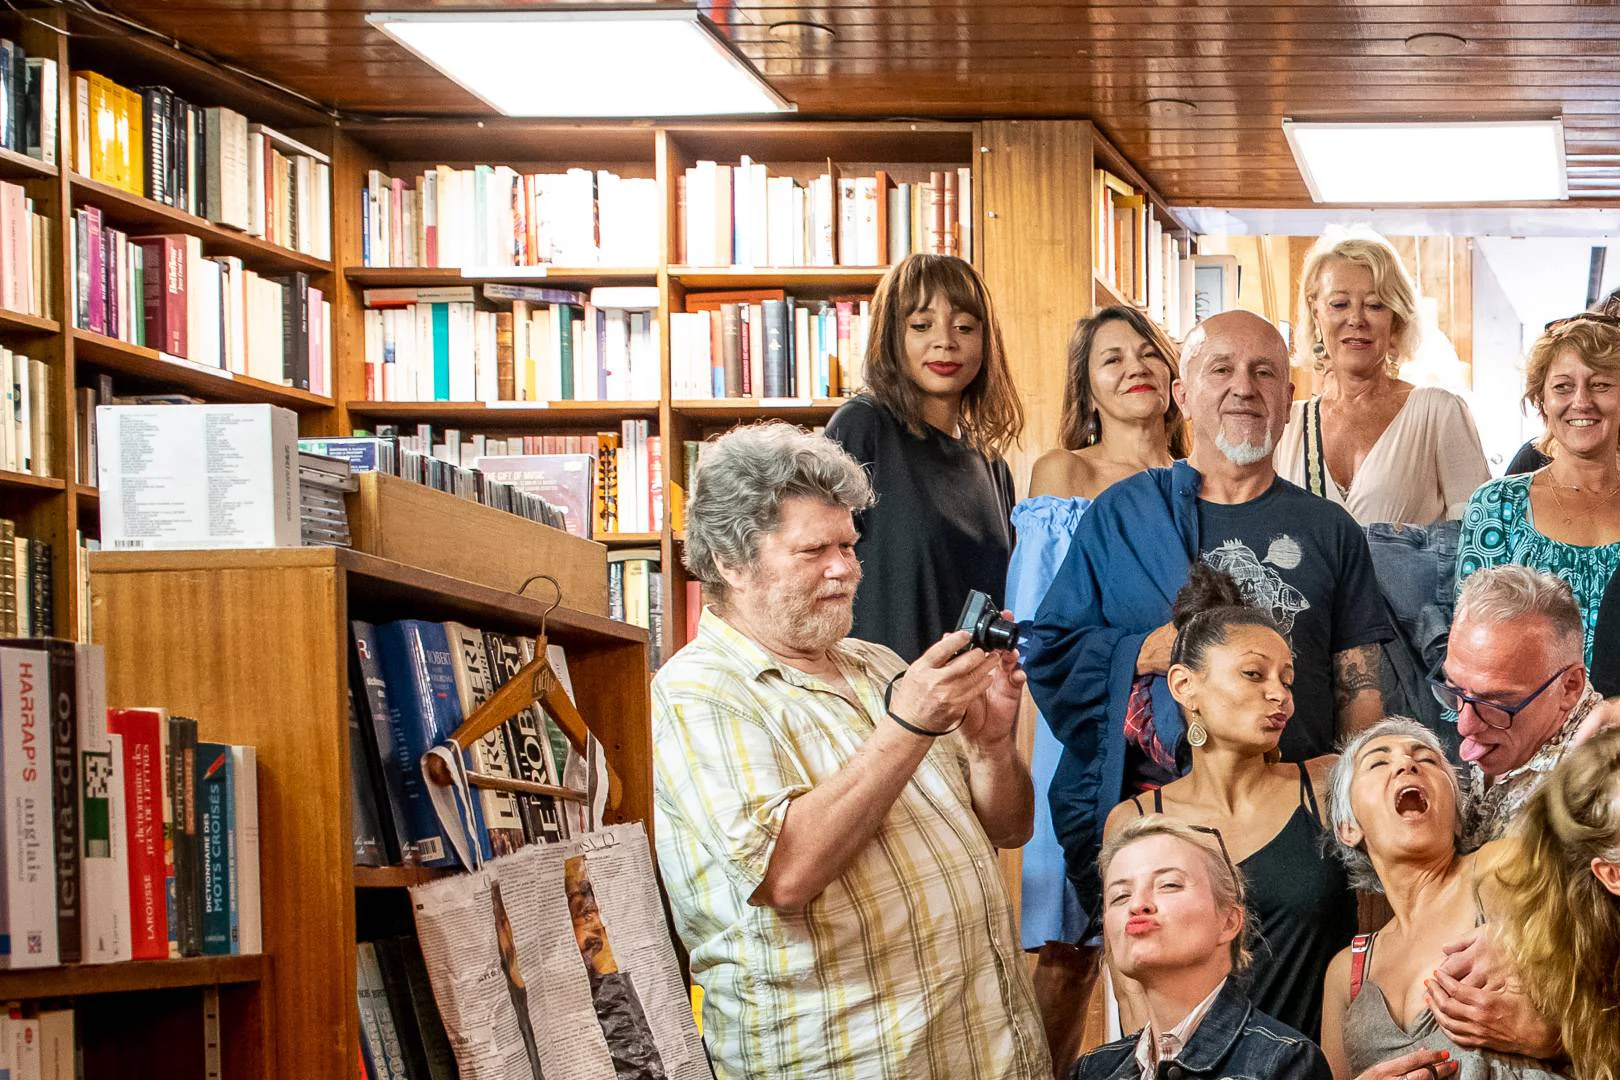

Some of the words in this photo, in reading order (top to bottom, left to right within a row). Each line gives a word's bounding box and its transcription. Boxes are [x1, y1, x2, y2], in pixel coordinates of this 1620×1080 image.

[19, 661, 38, 783] HARRAP'S
[24, 797, 42, 884] anglais
[202, 812, 210, 833] DES
[210, 783, 224, 858] CROISÉS
[145, 874, 156, 940] LAROUSSE
[203, 835, 213, 913] DICTIONNAIRE
[211, 862, 224, 913] MOTS
